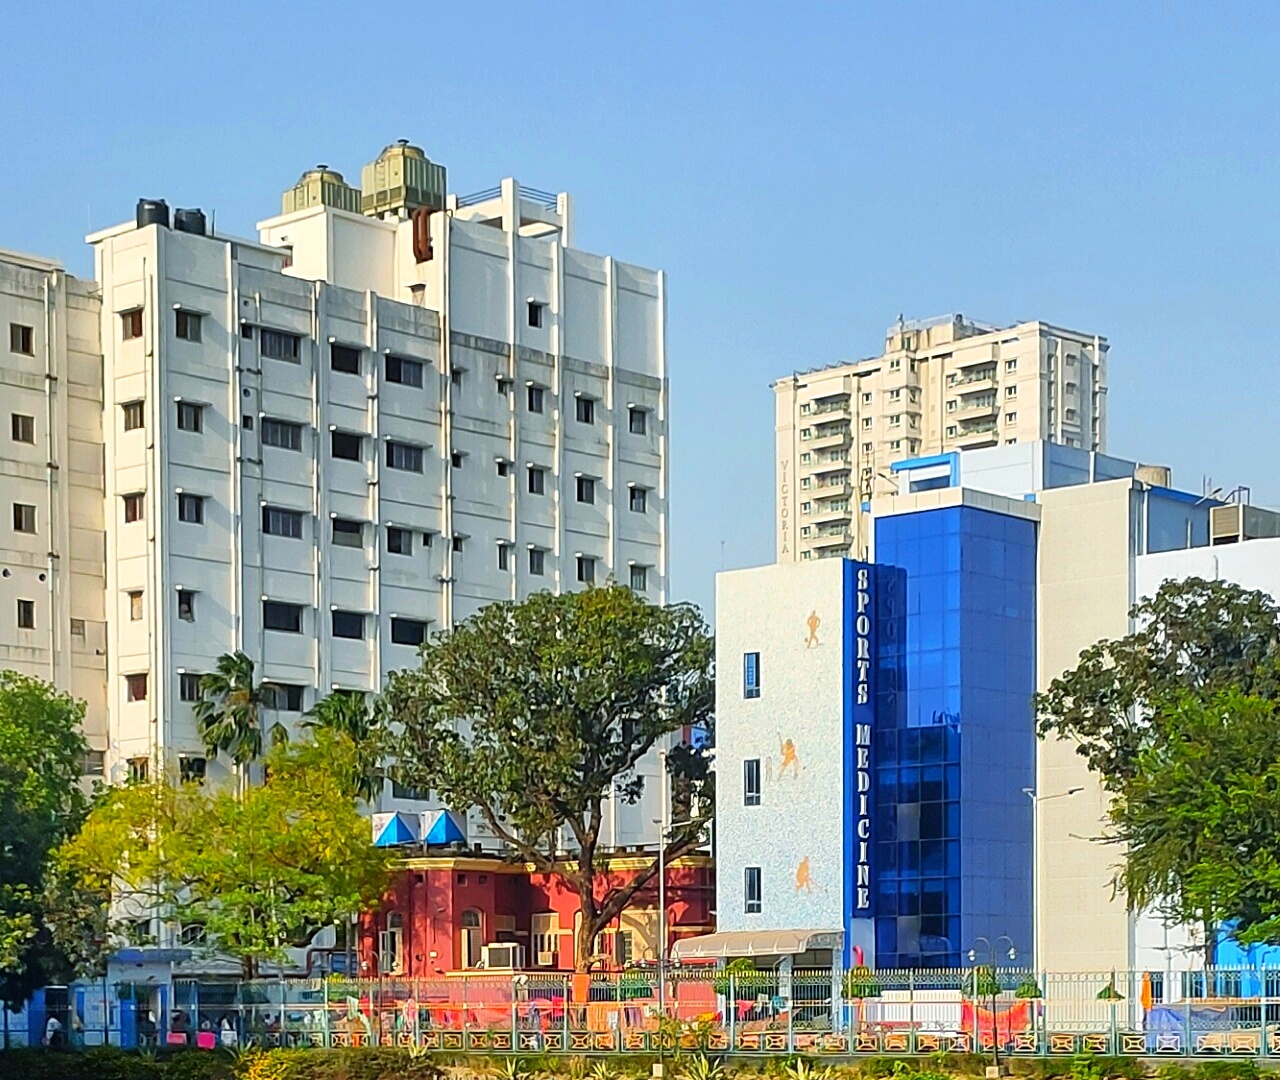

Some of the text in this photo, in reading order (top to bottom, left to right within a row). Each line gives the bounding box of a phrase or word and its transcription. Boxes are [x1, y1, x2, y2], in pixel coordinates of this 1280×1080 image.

[780, 459, 790, 554] VICTORIA
[856, 568, 871, 909] SPORTS MEDICINE
